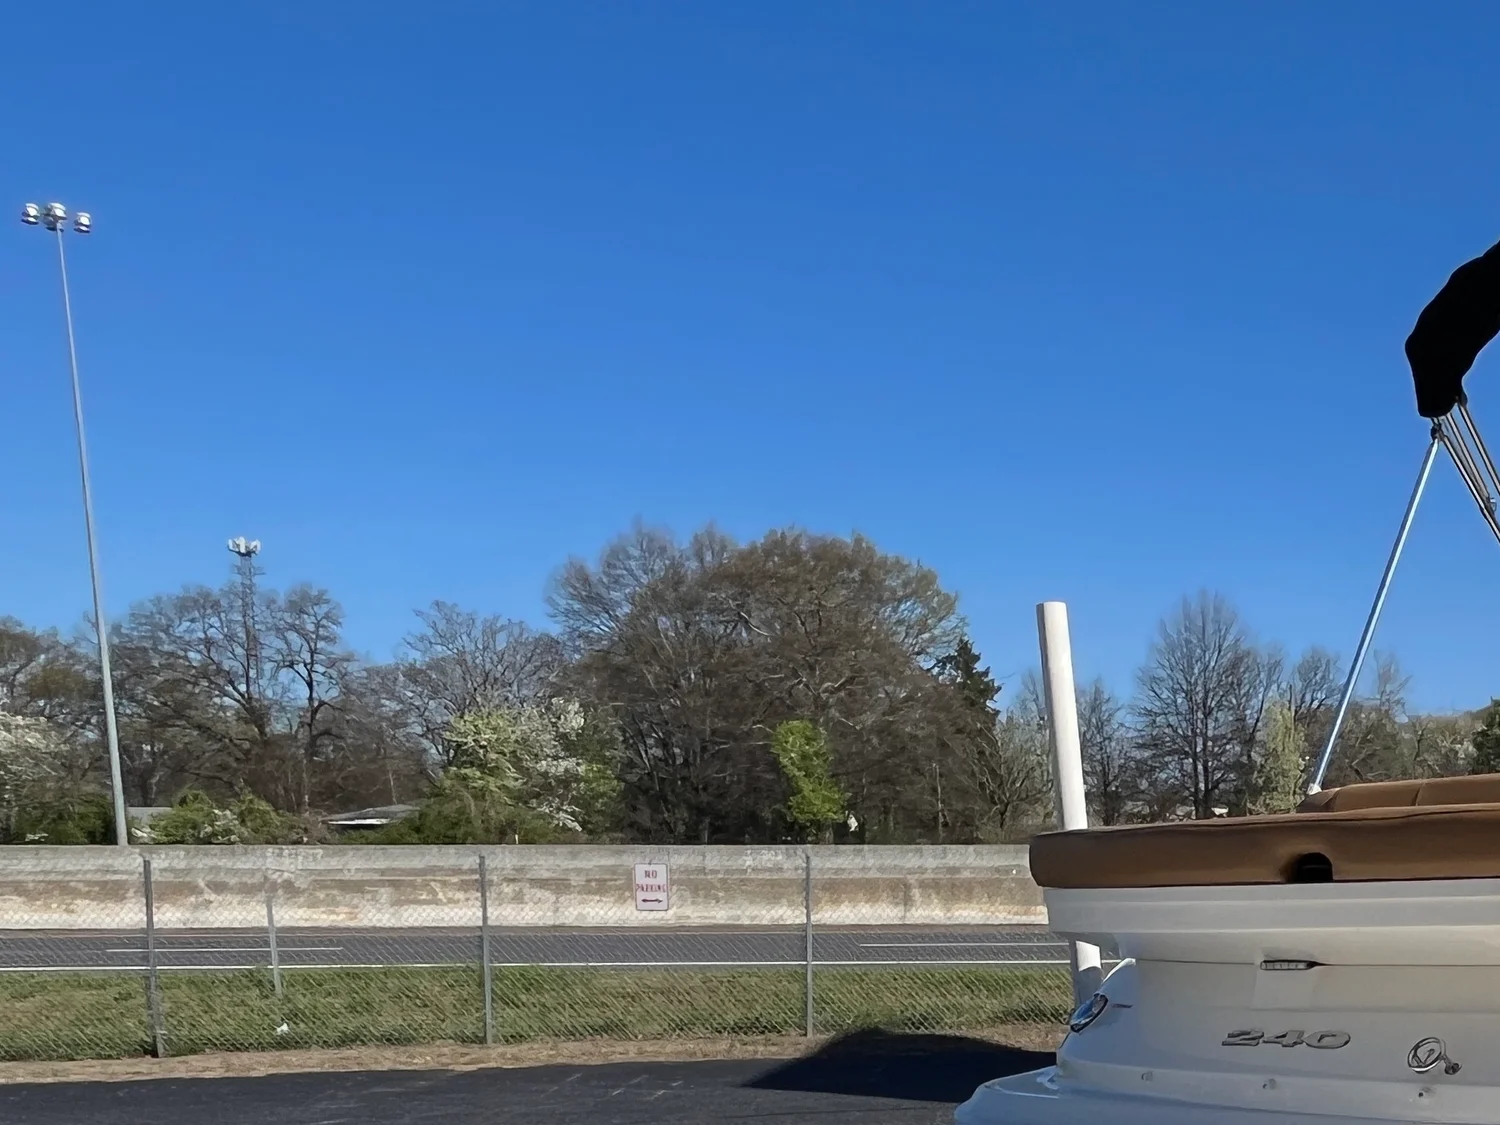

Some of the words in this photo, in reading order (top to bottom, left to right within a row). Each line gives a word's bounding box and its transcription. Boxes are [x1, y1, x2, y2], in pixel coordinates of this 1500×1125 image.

[644, 870, 658, 879] NO
[635, 883, 668, 893] PARKING
[1221, 1028, 1351, 1050] 240
